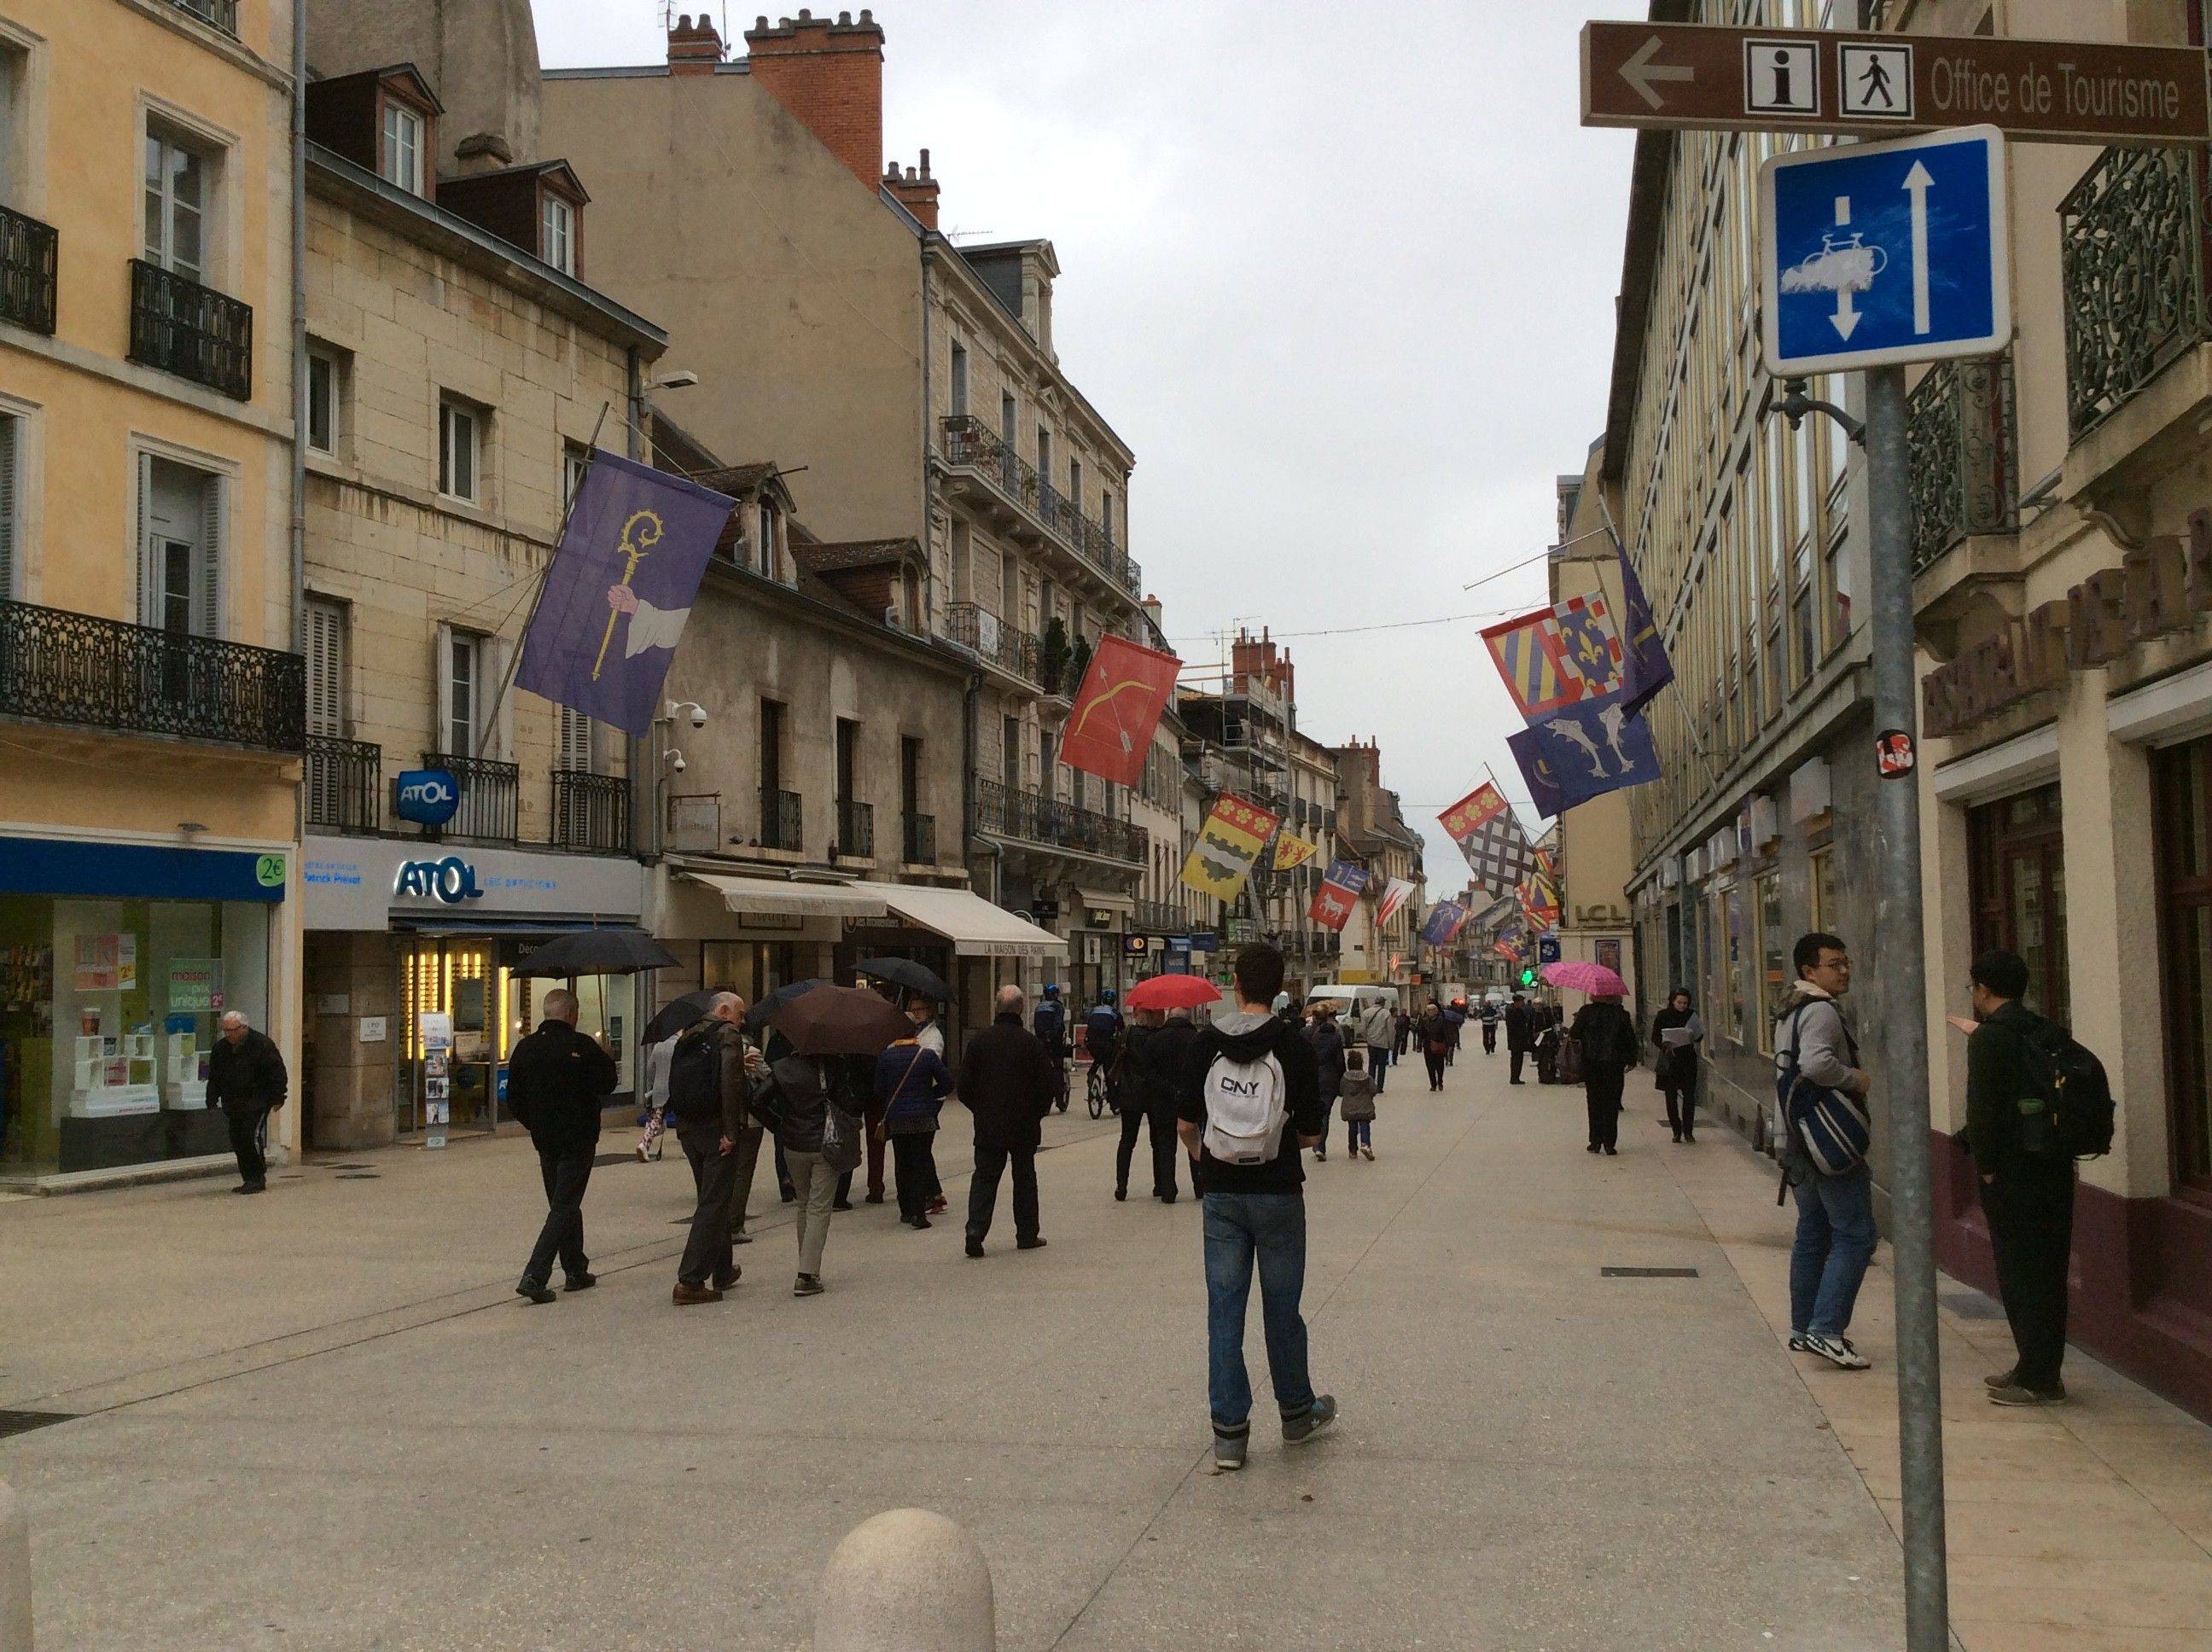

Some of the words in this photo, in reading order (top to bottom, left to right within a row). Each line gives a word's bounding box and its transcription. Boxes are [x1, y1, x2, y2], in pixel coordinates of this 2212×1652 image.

[1931, 56, 2009, 112] Office
[2019, 61, 2052, 114] de
[2058, 62, 2180, 119] Tourisme
[400, 782, 453, 804] ATOL
[393, 857, 485, 904] ATOL
[1575, 905, 1627, 921] LCL
[984, 944, 991, 954] LA
[994, 944, 1016, 955] MAISON
[1018, 944, 1028, 955] DES
[1220, 1076, 1260, 1096] CNY
